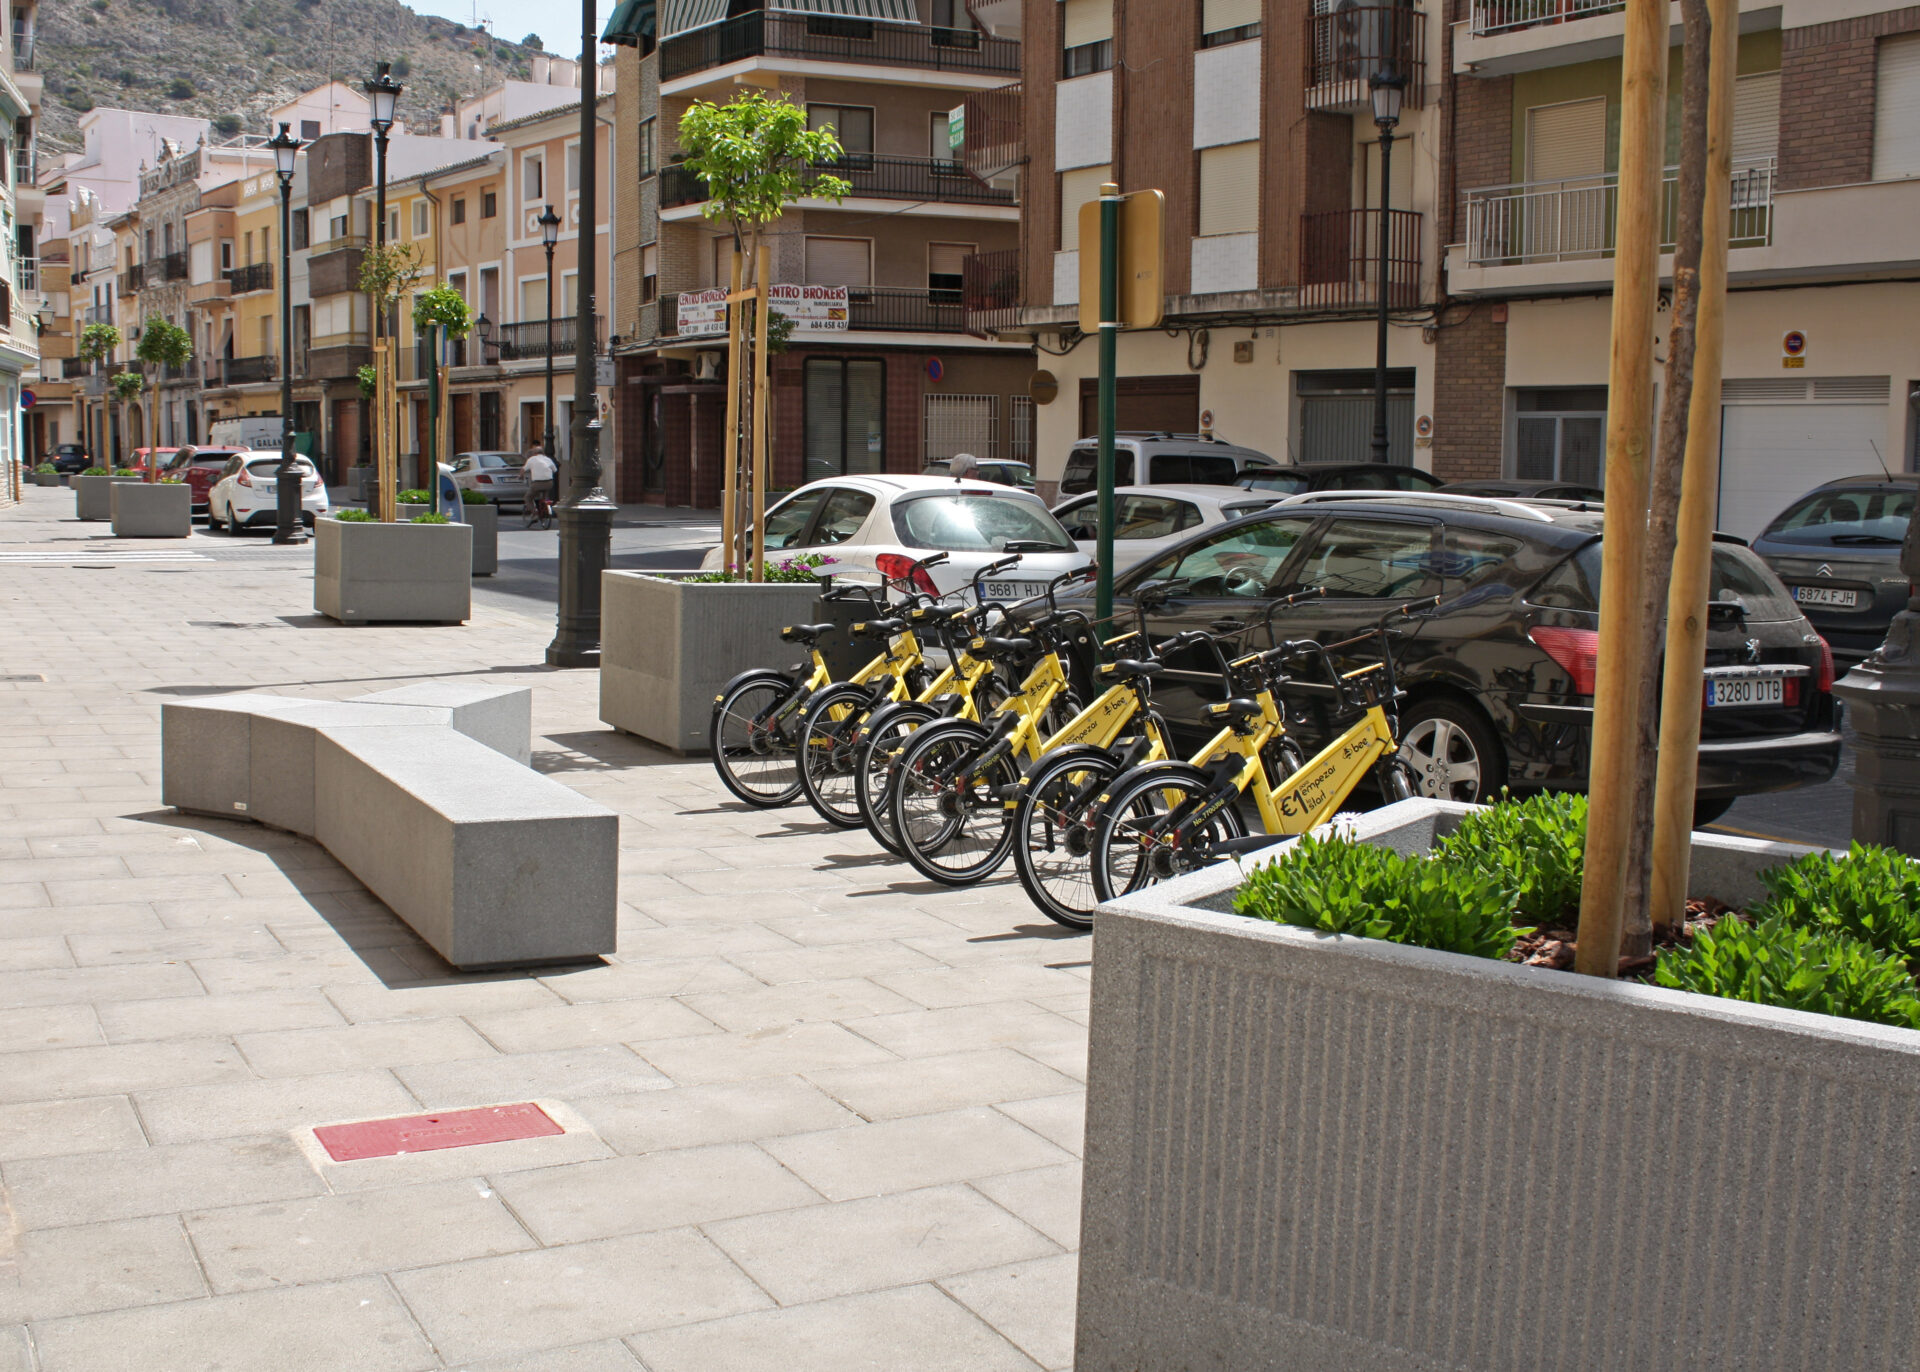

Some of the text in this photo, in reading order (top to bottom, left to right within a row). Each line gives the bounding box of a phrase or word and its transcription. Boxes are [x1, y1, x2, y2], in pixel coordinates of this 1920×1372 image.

[768, 286, 800, 298] ENTRO
[989, 583, 1017, 597] 9681
[1799, 588, 1854, 604] 6874 FJH
[1717, 681, 1780, 702] 3280 DTB
[1112, 697, 1127, 710] bee
[1351, 737, 1369, 753] bee
[1301, 765, 1336, 796] empezar
[1281, 789, 1308, 816] €1
